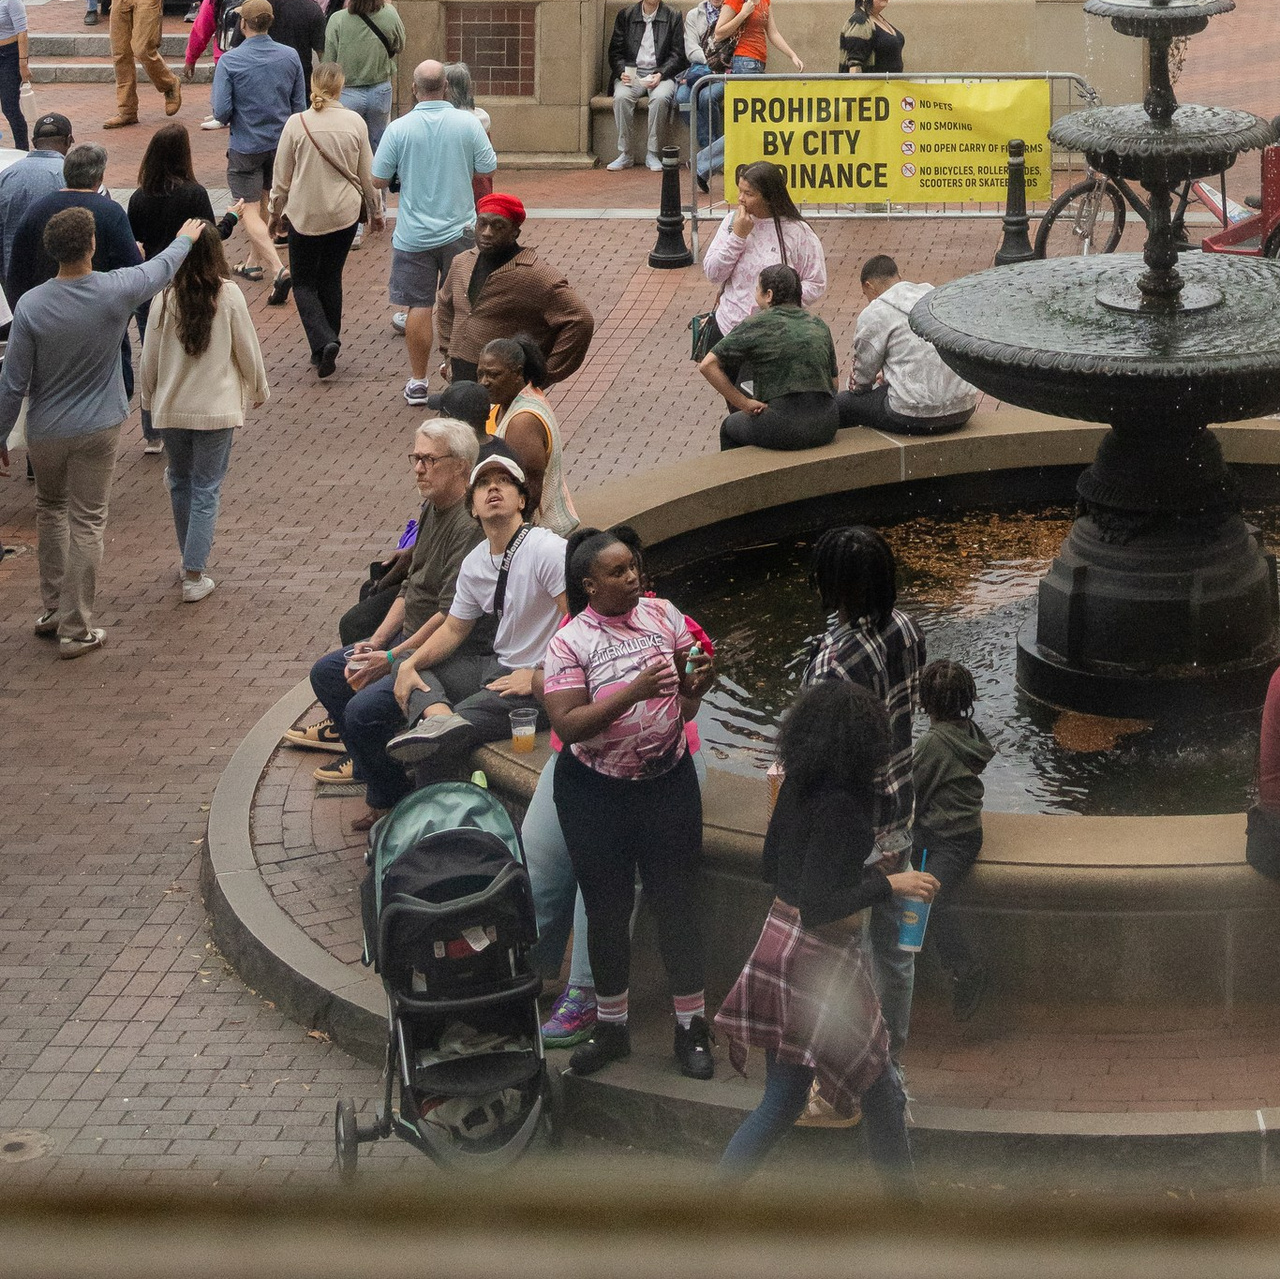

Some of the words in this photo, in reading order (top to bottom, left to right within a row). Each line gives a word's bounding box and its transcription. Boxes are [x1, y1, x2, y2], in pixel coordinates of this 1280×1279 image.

[733, 96, 890, 123] PROHIBITED
[919, 100, 931, 108] NO
[933, 102, 953, 111] PETS
[919, 122, 932, 130] NO
[934, 121, 973, 131] SMOKING
[763, 130, 795, 156] BY
[803, 129, 861, 155] CITY
[919, 144, 932, 153] NO
[934, 144, 957, 152] OPEN
[959, 143, 986, 152] CARRY
[988, 144, 999, 152] OF
[919, 167, 932, 175] NO
[934, 166, 975, 176] BICYCLES,
[919, 179, 963, 188] SCOOTERS
[965, 179, 977, 187] OR
[501, 528, 529, 572] lululemon
[588, 643, 624, 668] STAY
[624, 634, 664, 654] WOKE
